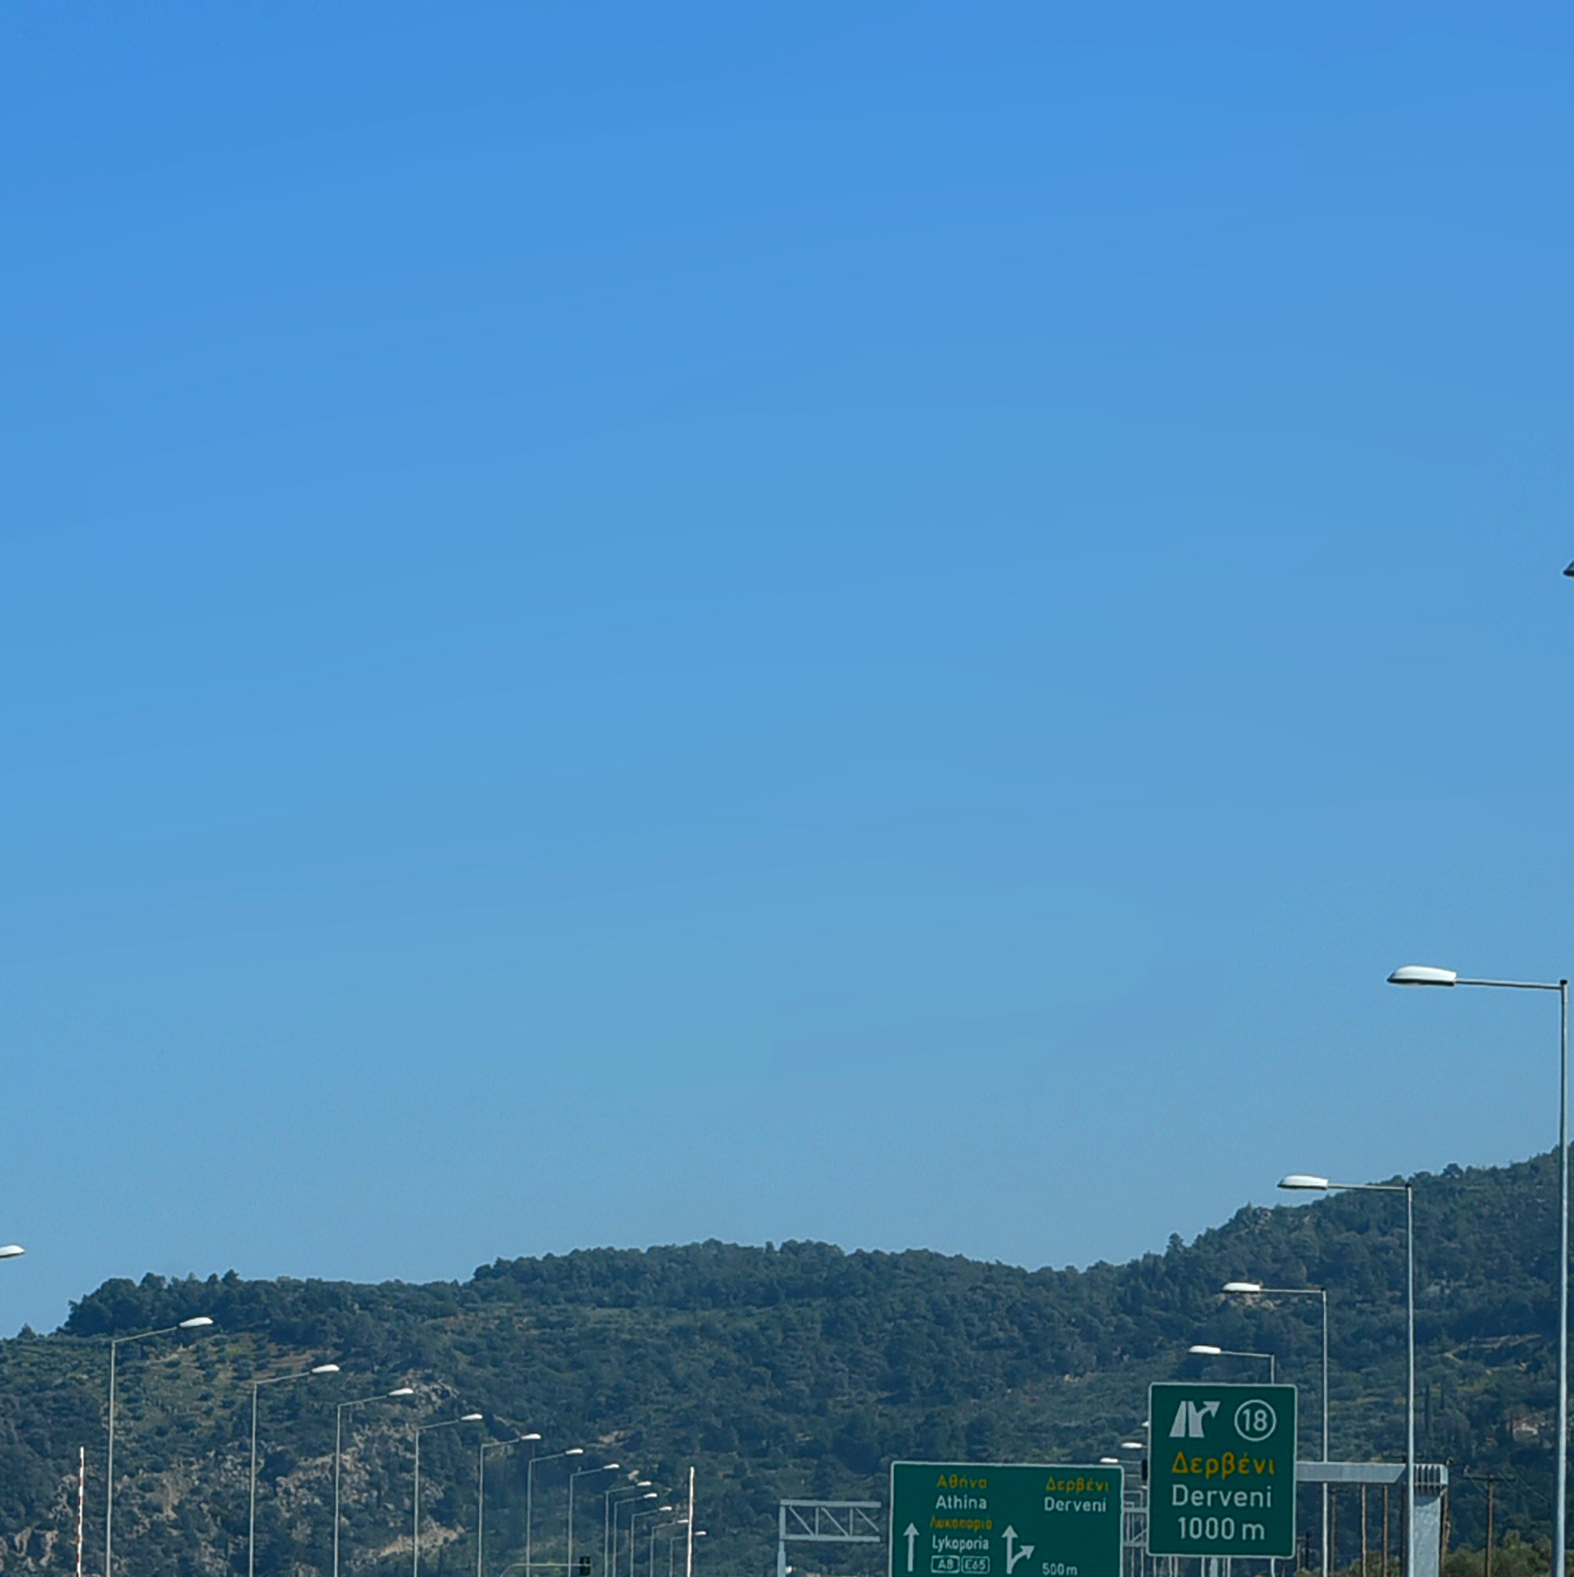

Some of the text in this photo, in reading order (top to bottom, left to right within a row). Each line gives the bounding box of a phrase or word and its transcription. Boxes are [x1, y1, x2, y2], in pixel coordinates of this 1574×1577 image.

[1241, 1408, 1268, 1432] 18
[1171, 1451, 1275, 1480] Δερβένι
[936, 1473, 989, 1490] Αθήνα
[1045, 1477, 1111, 1495] Δερβένι
[935, 1494, 988, 1510] Athina
[1043, 1496, 1107, 1513] Derveni
[1171, 1484, 1272, 1508] Derveni
[1177, 1516, 1265, 1541] 1000 m
[931, 1534, 989, 1553] Lykoporia
[937, 1559, 954, 1570] A8
[964, 1559, 987, 1570] E65
